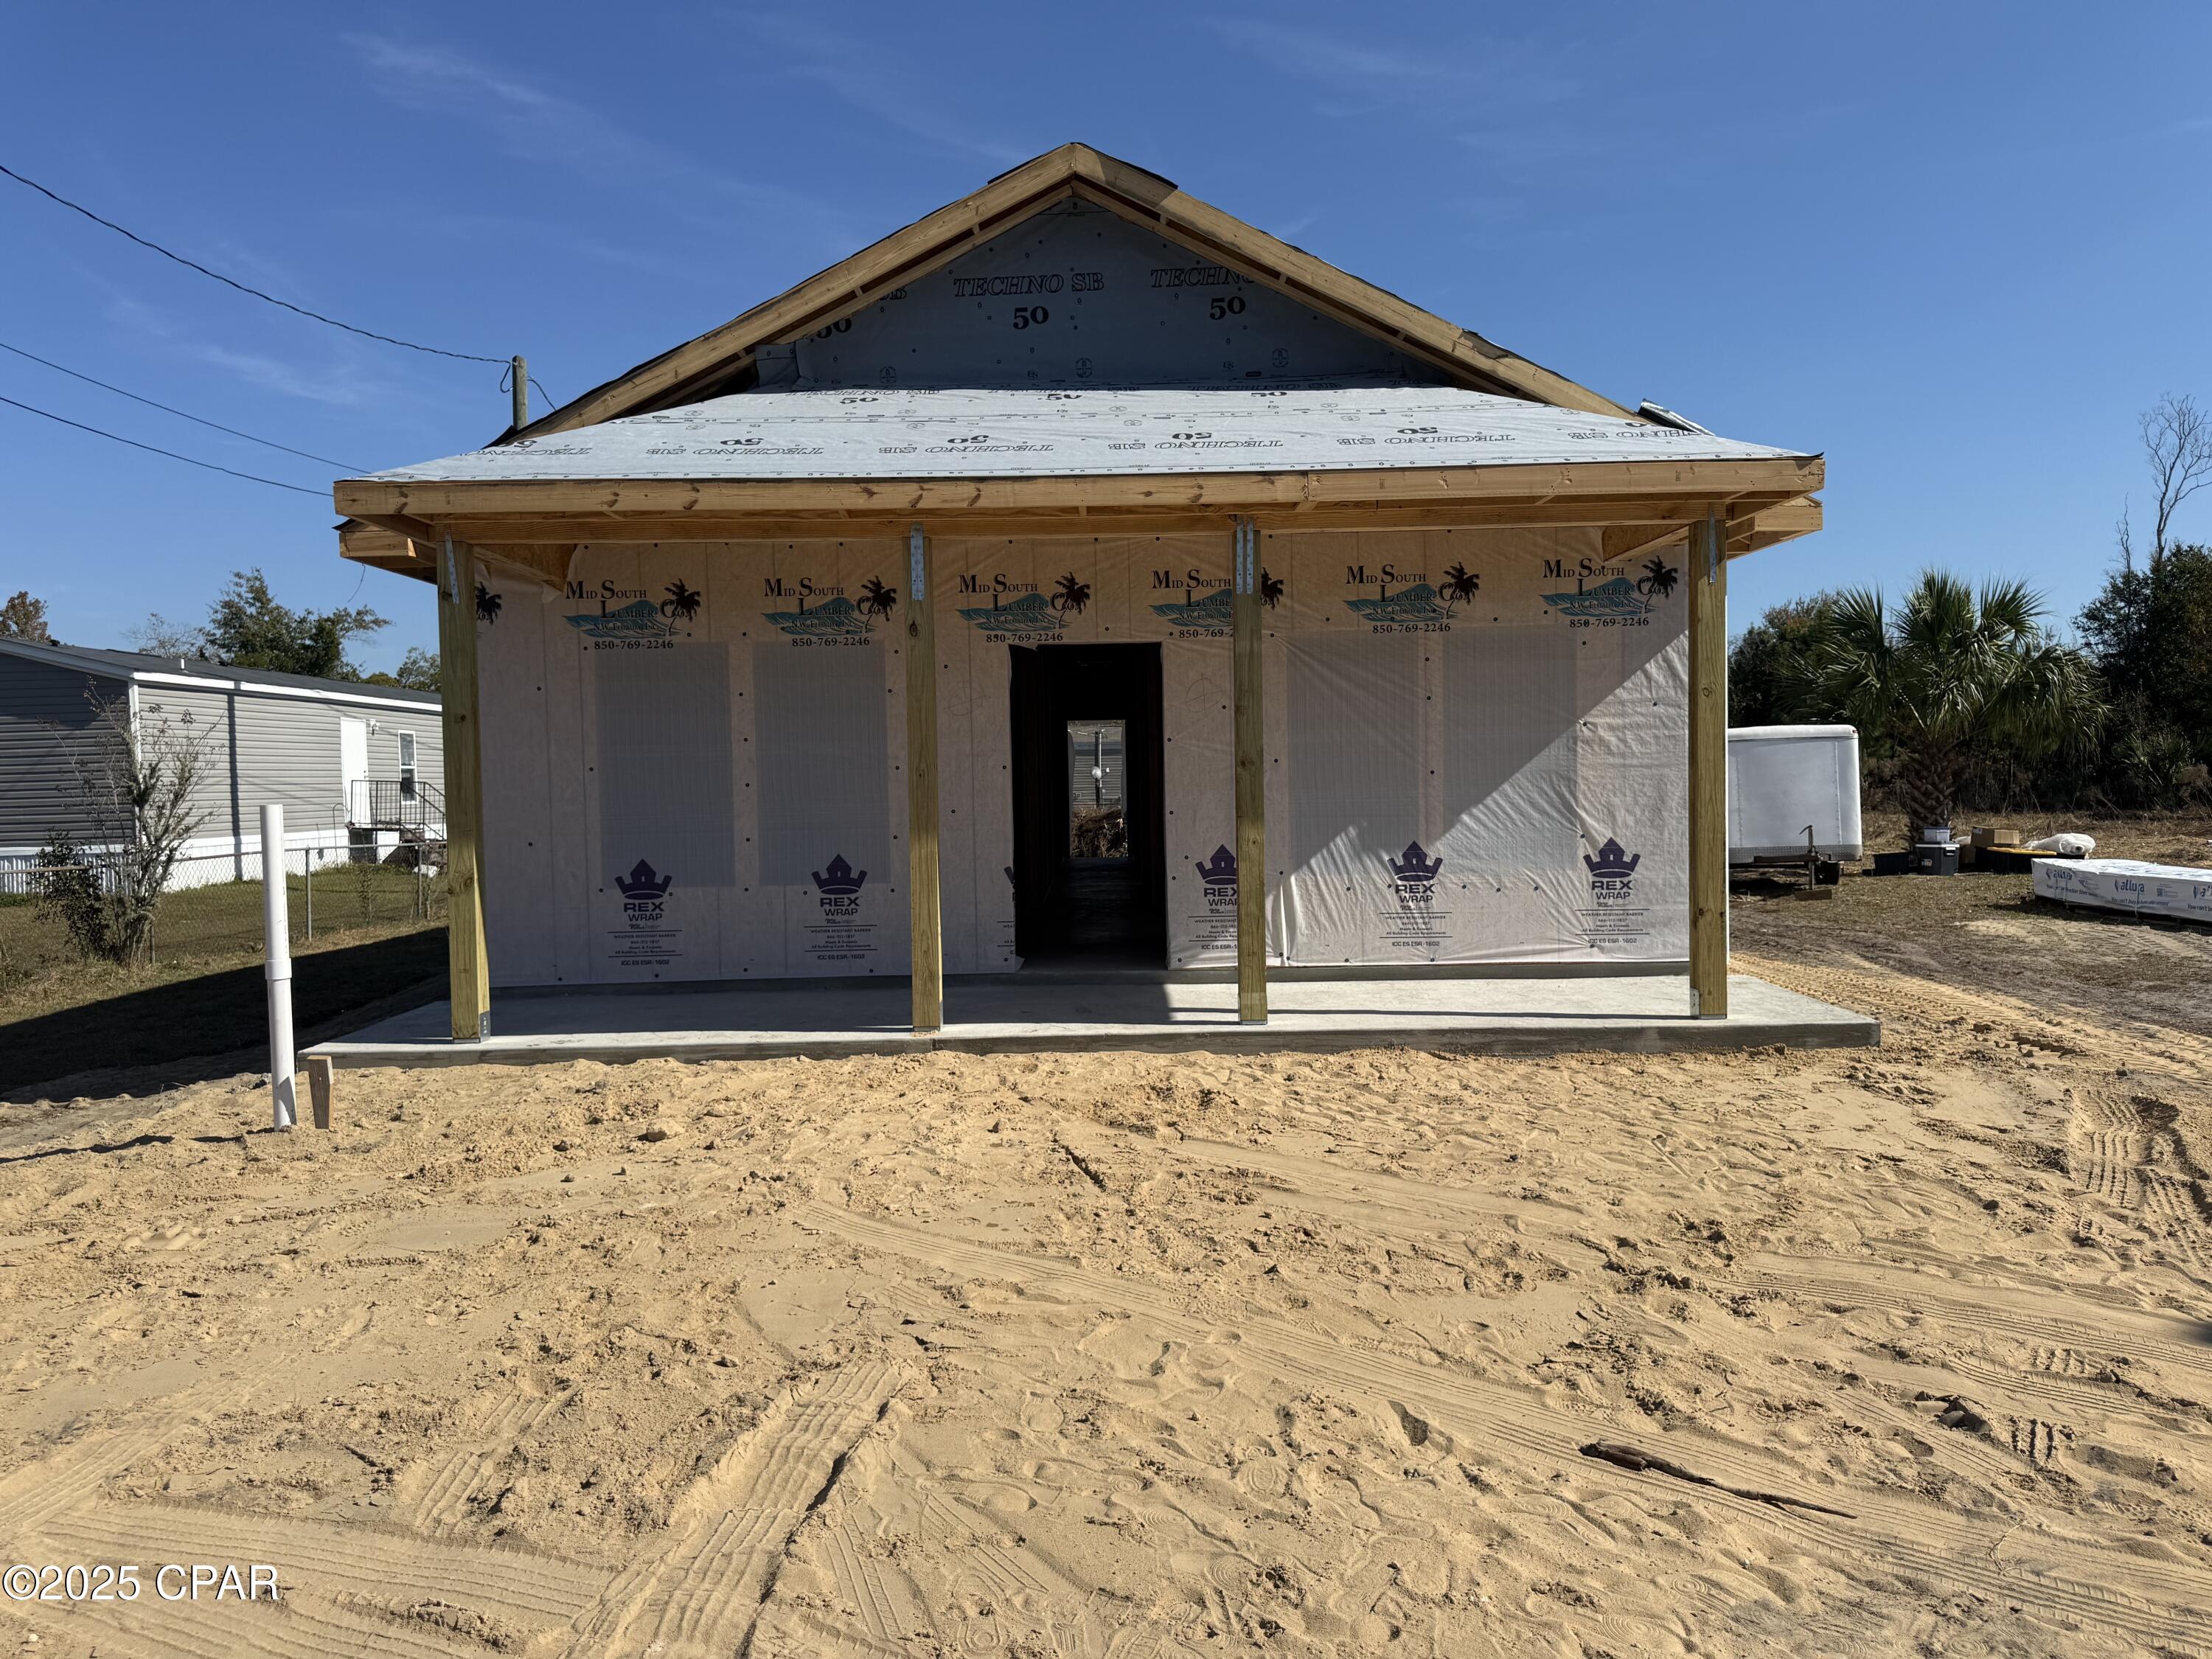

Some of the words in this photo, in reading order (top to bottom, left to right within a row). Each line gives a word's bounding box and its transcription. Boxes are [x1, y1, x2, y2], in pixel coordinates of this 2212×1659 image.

[1151, 266, 1254, 288] TECHN
[953, 274, 1064, 296] TECHNO
[1071, 272, 1105, 292] SB
[1210, 296, 1245, 320] 50
[1013, 306, 1049, 330] 50
[947, 435, 990, 444] 50
[1172, 432, 1213, 440] 50
[1385, 434, 1515, 445] TECHNO
[925, 445, 1054, 453] TECHNO
[1155, 441, 1283, 449] TECHNO
[1543, 560, 1575, 578] MID
[1579, 558, 1624, 577] SOUTH
[1152, 570, 1183, 588] MID
[1186, 569, 1231, 588] SOUTH
[1346, 566, 1377, 584] MID
[1380, 564, 1426, 583] SOUTH
[764, 578, 796, 597] MID
[799, 577, 844, 597] SOUTH
[959, 574, 990, 593] MID
[992, 574, 1038, 593] SOUTH
[566, 580, 597, 599] MID
[601, 580, 647, 599] SOUTH
[1186, 589, 1233, 608] LUMBE
[1569, 617, 1649, 628] 850-769-2246
[1179, 628, 1234, 639] 850-769-2
[1372, 623, 1450, 634] 850-769-2246
[594, 640, 673, 650] 850-769-2246
[792, 636, 870, 647] 850-769-2246
[1395, 884, 1435, 894] REX
[1591, 880, 1633, 890] REX
[2121, 879, 2145, 892] allura
[1399, 895, 1433, 903] WRAP
[1596, 891, 1630, 900] WRAP
[624, 902, 665, 912] REX
[820, 897, 860, 907] REX
[824, 908, 858, 916] WRAP
[627, 914, 663, 922] WRAP
